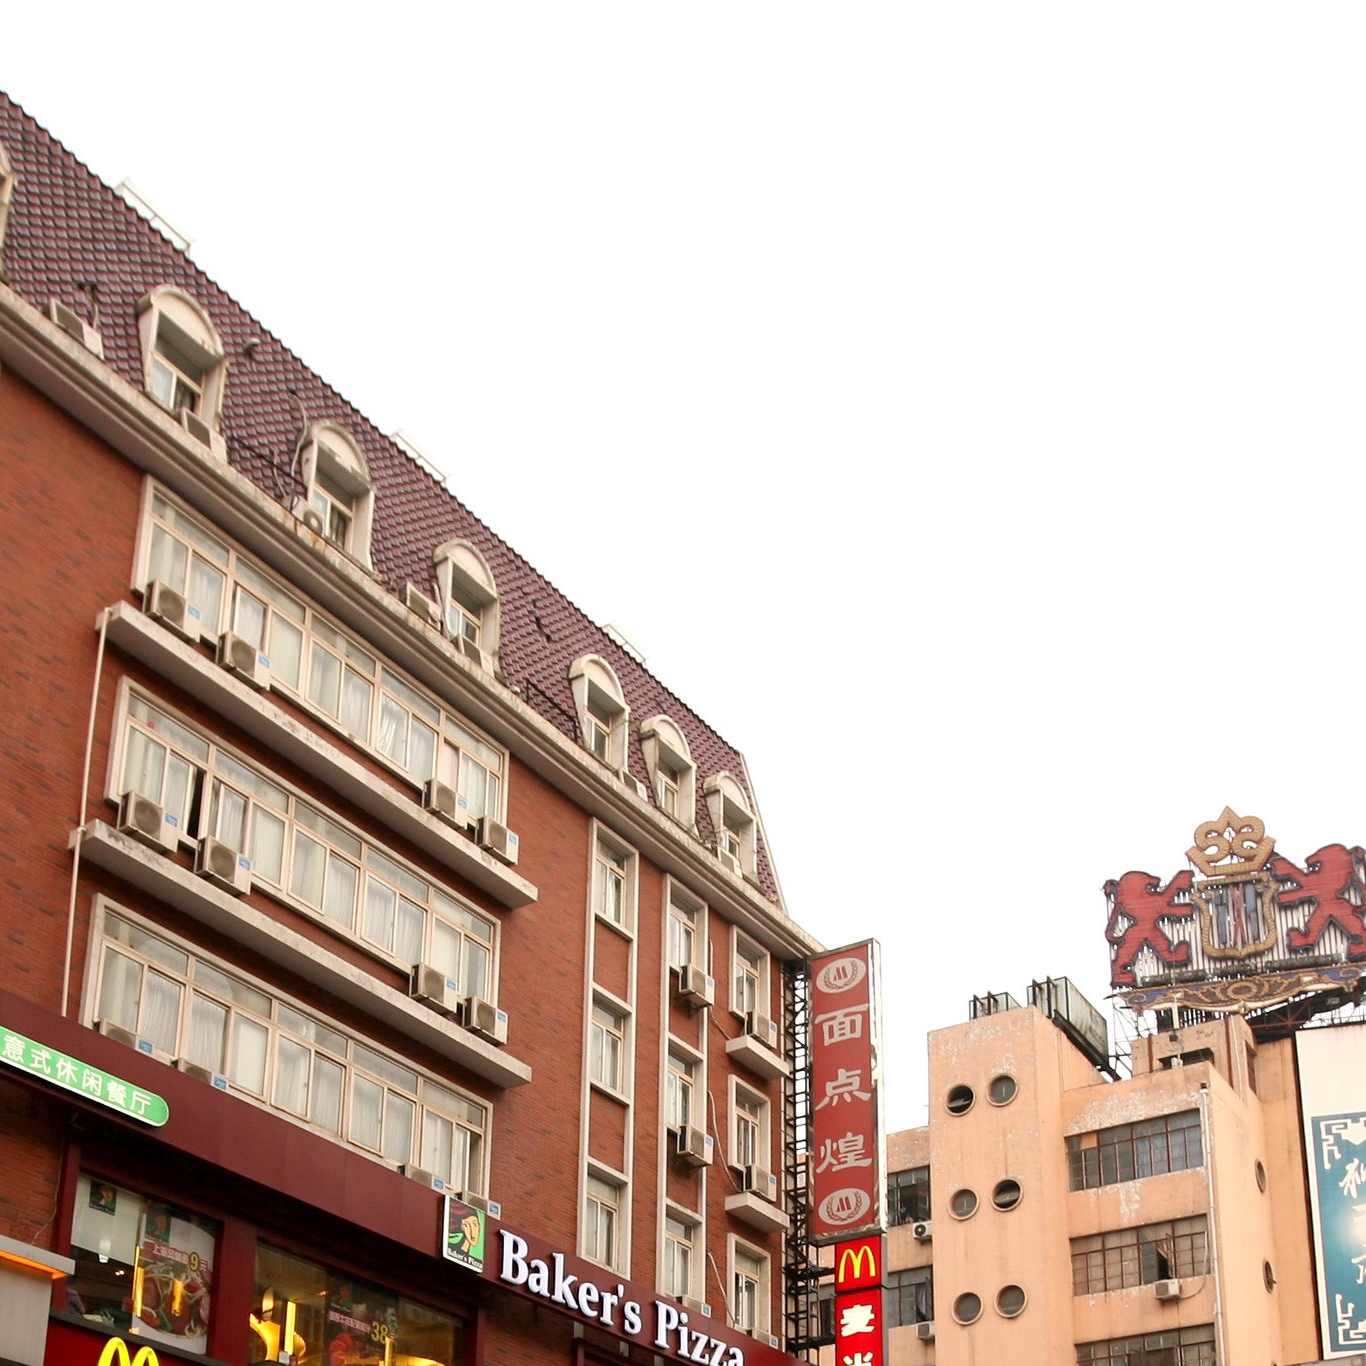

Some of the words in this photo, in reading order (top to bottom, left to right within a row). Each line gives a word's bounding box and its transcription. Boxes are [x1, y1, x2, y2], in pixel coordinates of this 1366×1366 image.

[2, 1034, 154, 1116] 意式休闲餐厅
[814, 1003, 872, 1174] 面点煌
[498, 1229, 642, 1336] Baker's
